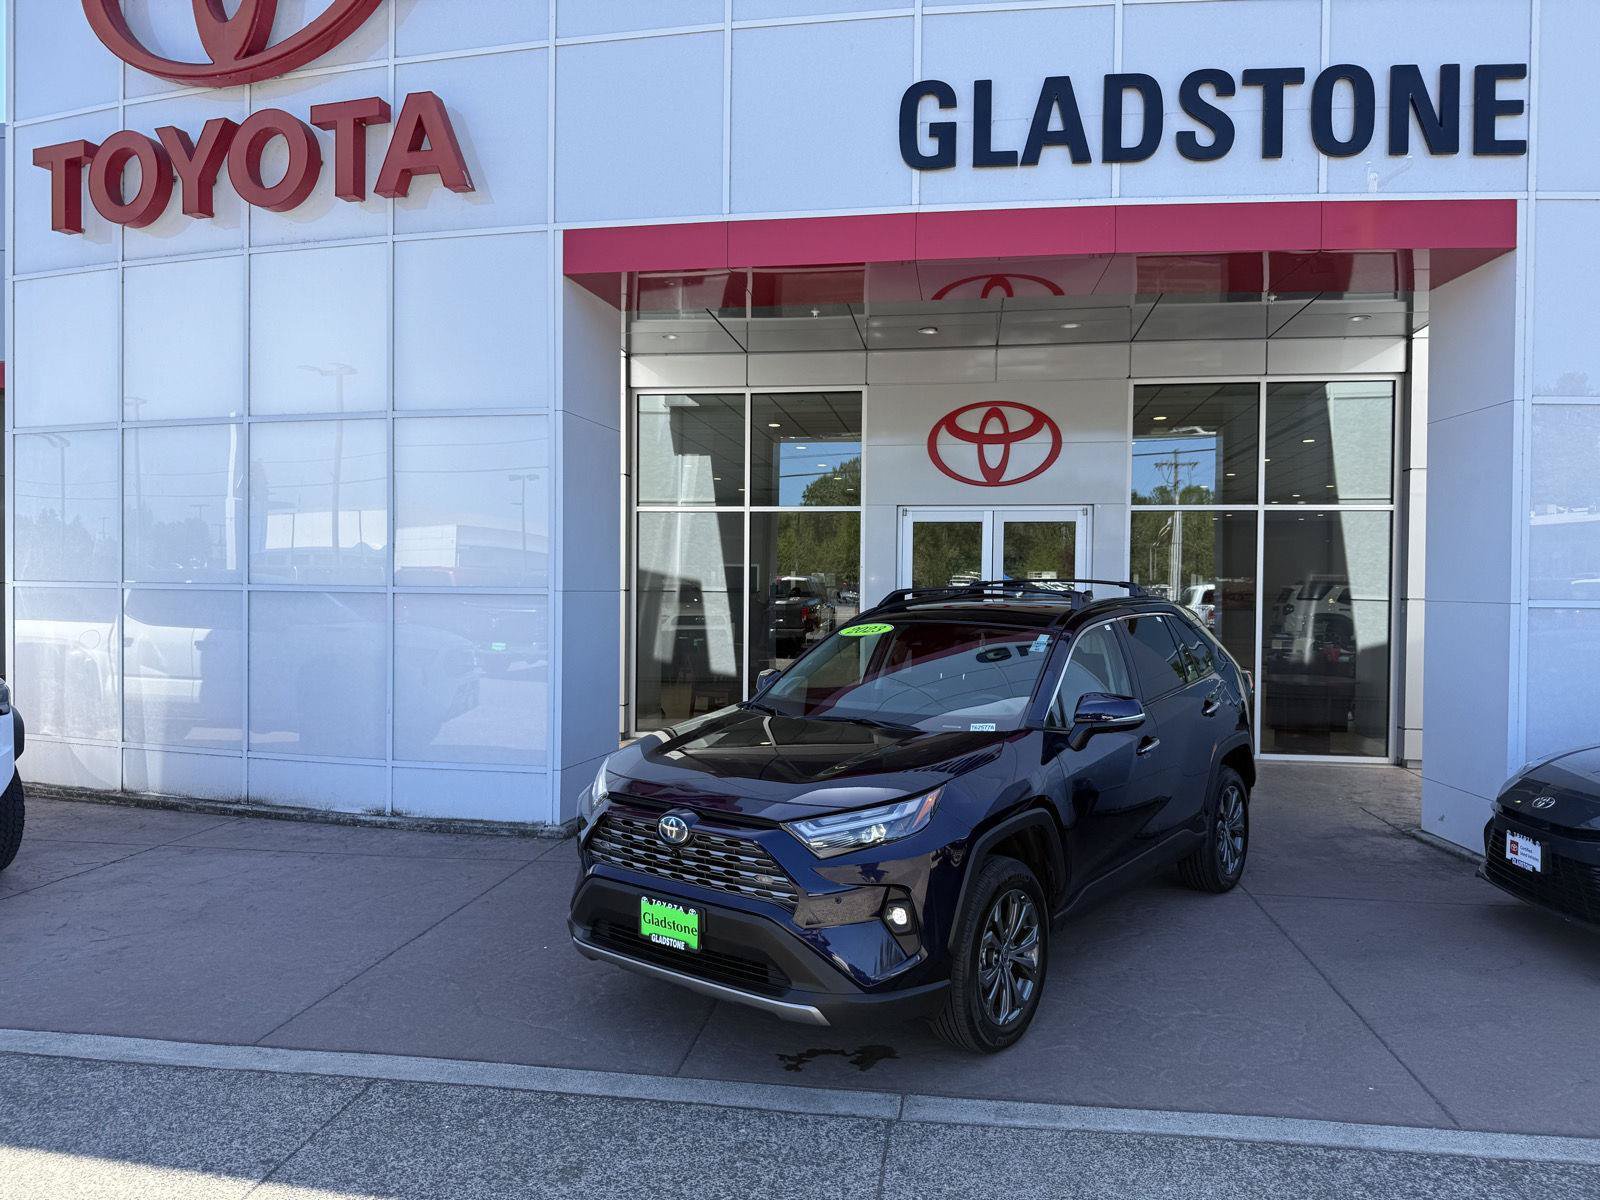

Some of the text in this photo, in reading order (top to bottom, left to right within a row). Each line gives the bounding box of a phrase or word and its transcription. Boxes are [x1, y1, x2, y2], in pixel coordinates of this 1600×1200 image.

[899, 63, 1528, 171] GLADSTONE
[32, 91, 476, 235] TOYOTA
[652, 899, 683, 912] TOYOTA
[643, 912, 697, 936] Gladstone
[651, 934, 685, 950] GLADSTONE
